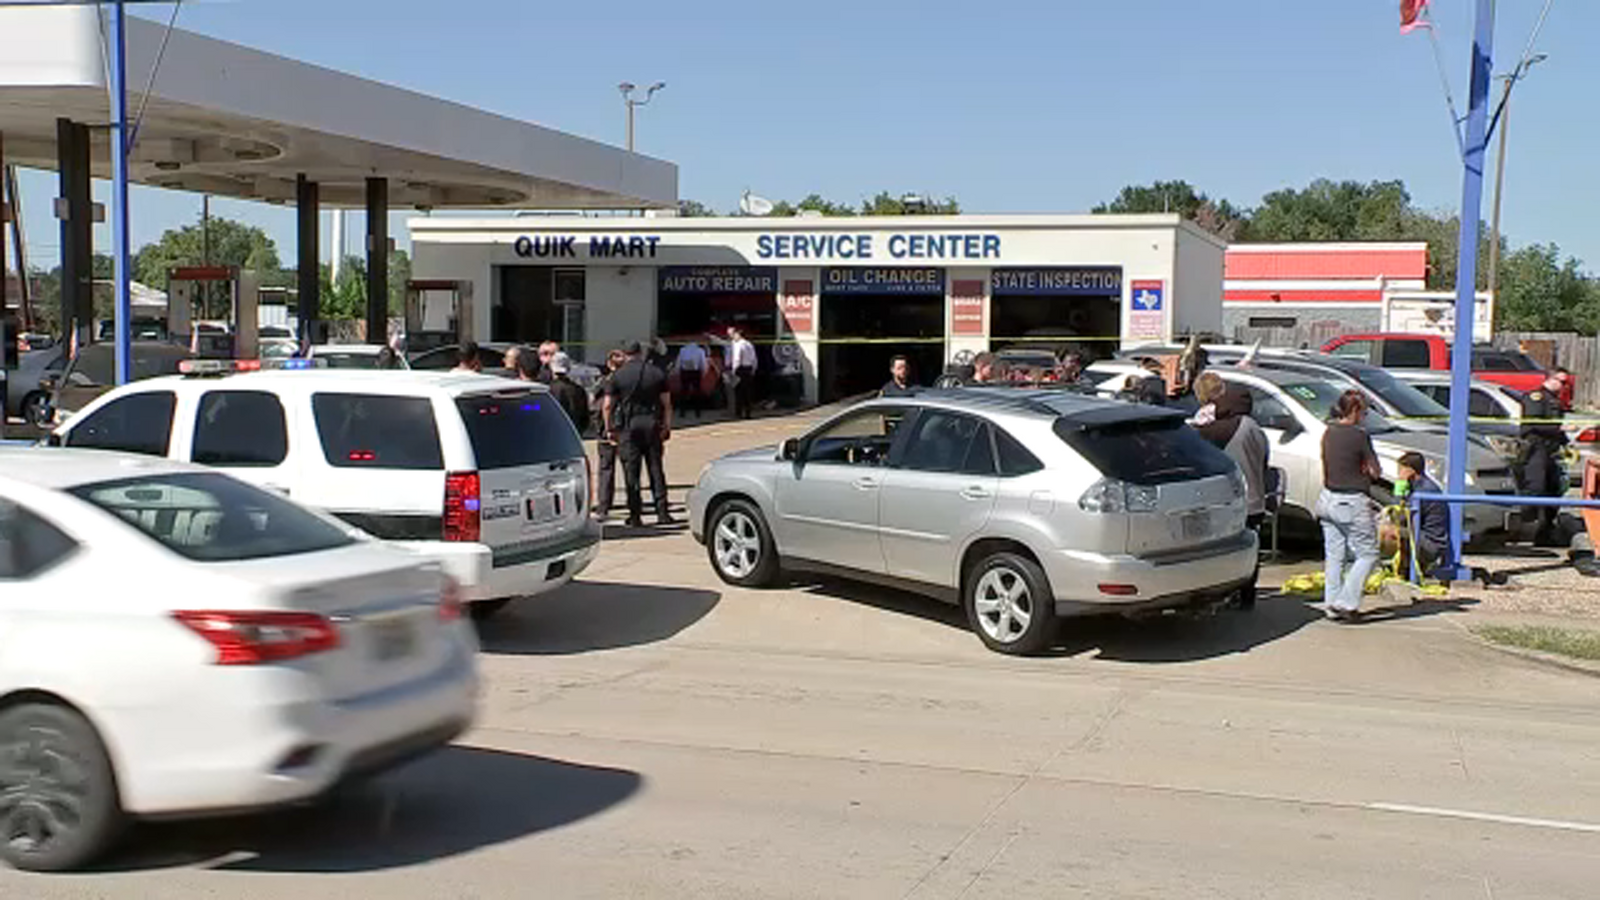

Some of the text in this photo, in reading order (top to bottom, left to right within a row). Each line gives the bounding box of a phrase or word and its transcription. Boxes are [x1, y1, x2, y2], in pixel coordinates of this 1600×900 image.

[514, 236, 660, 258] QUIK MART
[757, 235, 1001, 258] SERVICE CENTER
[829, 269, 936, 283] OIL CHANGE
[992, 272, 1035, 289] STATE
[1039, 272, 1122, 289] INSPECTION
[663, 277, 771, 291] AUTO REPAIR
[786, 295, 812, 308] A/C
